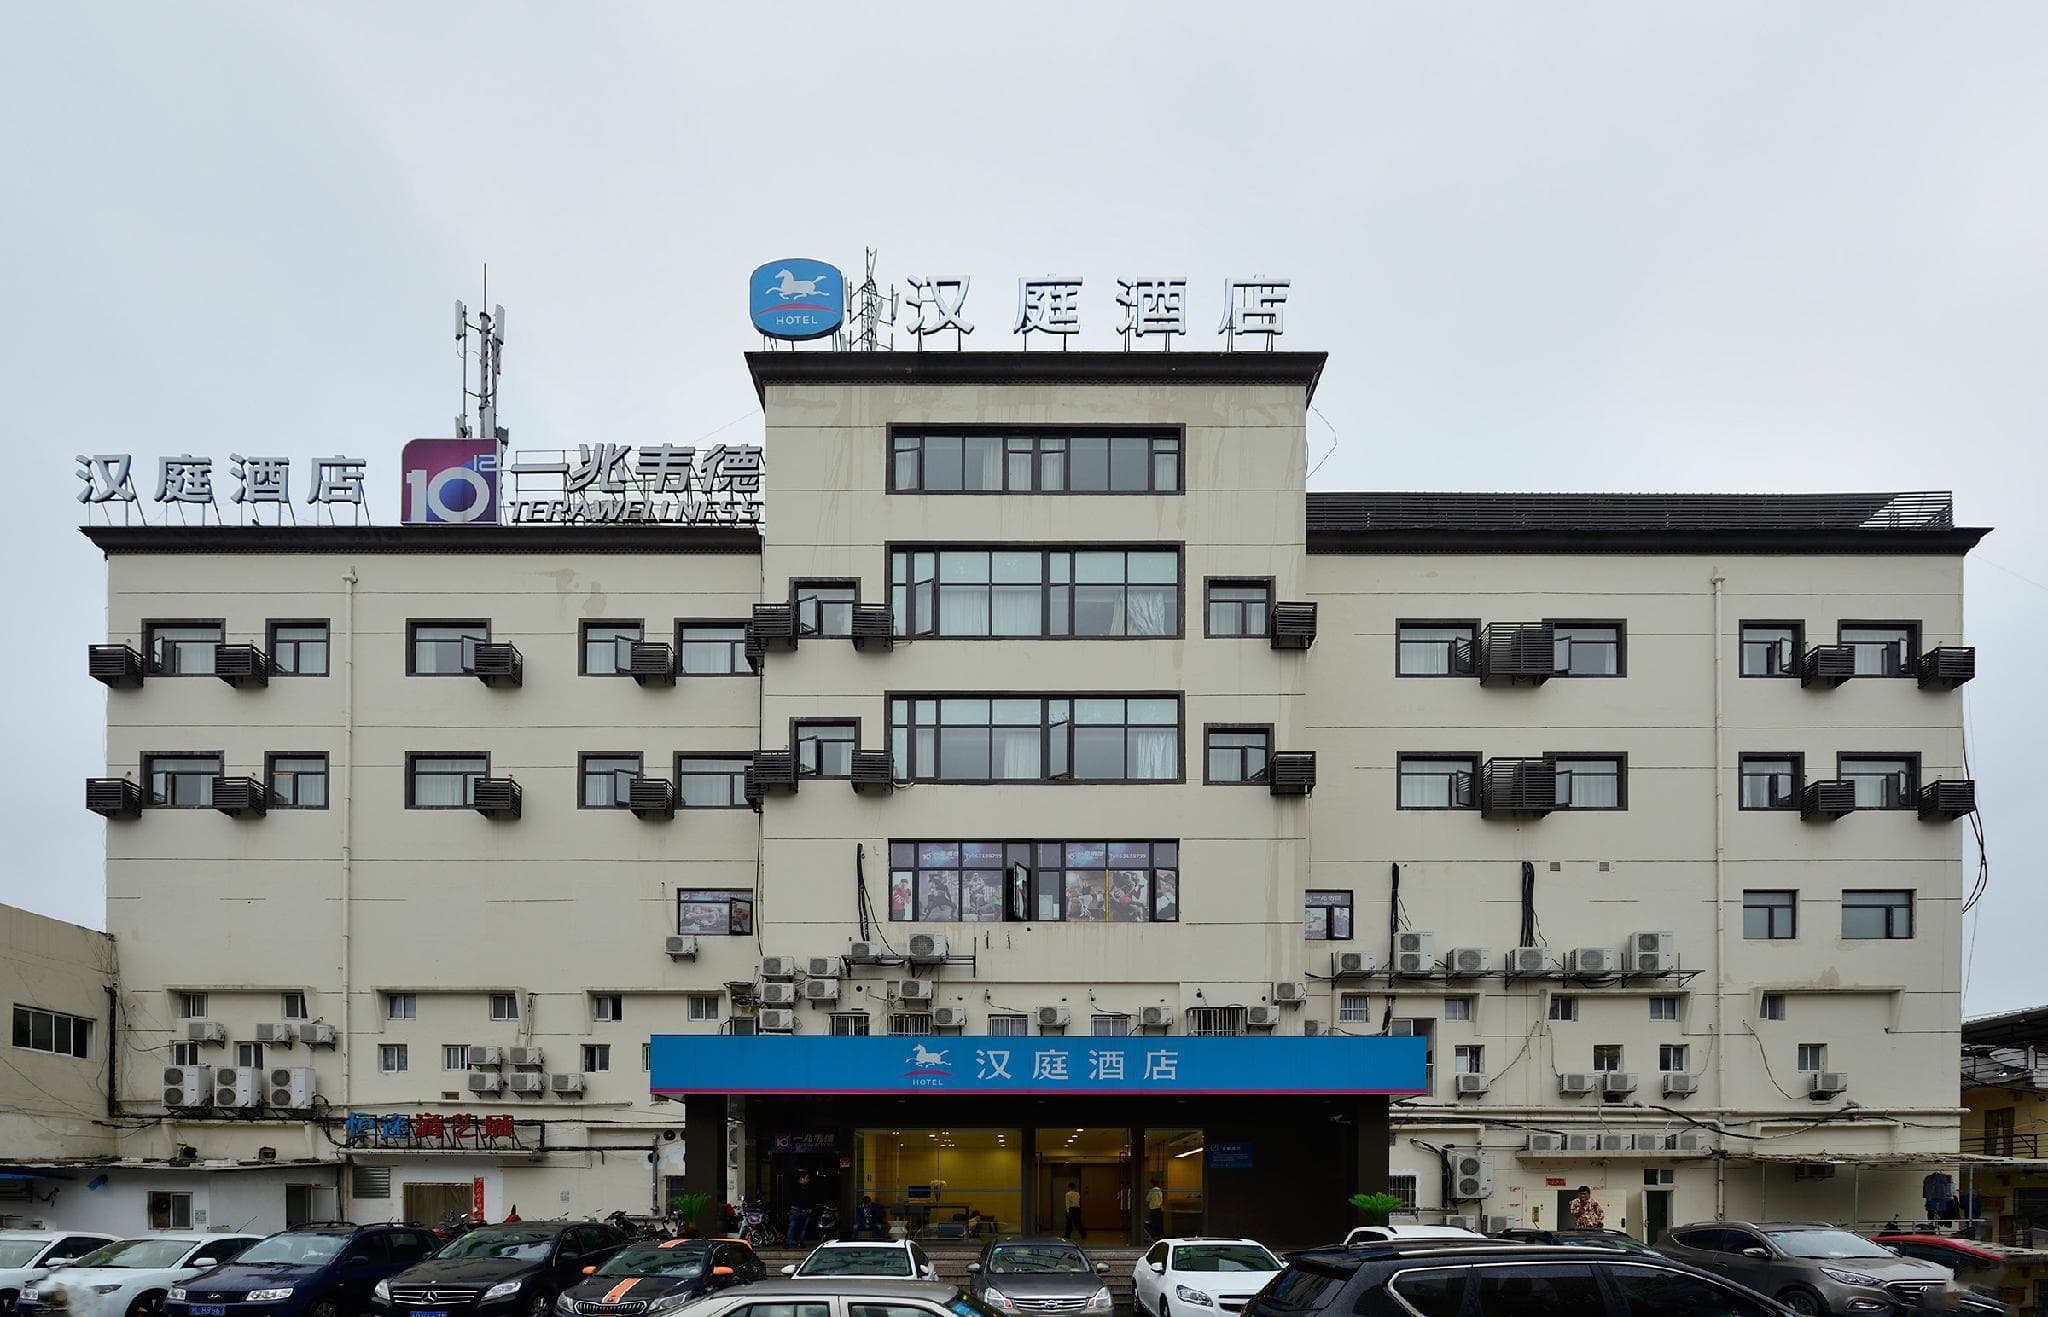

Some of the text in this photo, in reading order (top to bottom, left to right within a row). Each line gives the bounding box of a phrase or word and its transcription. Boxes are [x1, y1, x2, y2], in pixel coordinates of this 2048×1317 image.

[776, 314, 818, 326] HOTEL
[906, 274, 1292, 336] 汉庭酒店
[75, 453, 368, 504] 汉庭酒店
[511, 443, 762, 493] 一兆韦德
[510, 499, 762, 523] TERAWELLNESS
[975, 1049, 1179, 1081] 汉庭酒店
